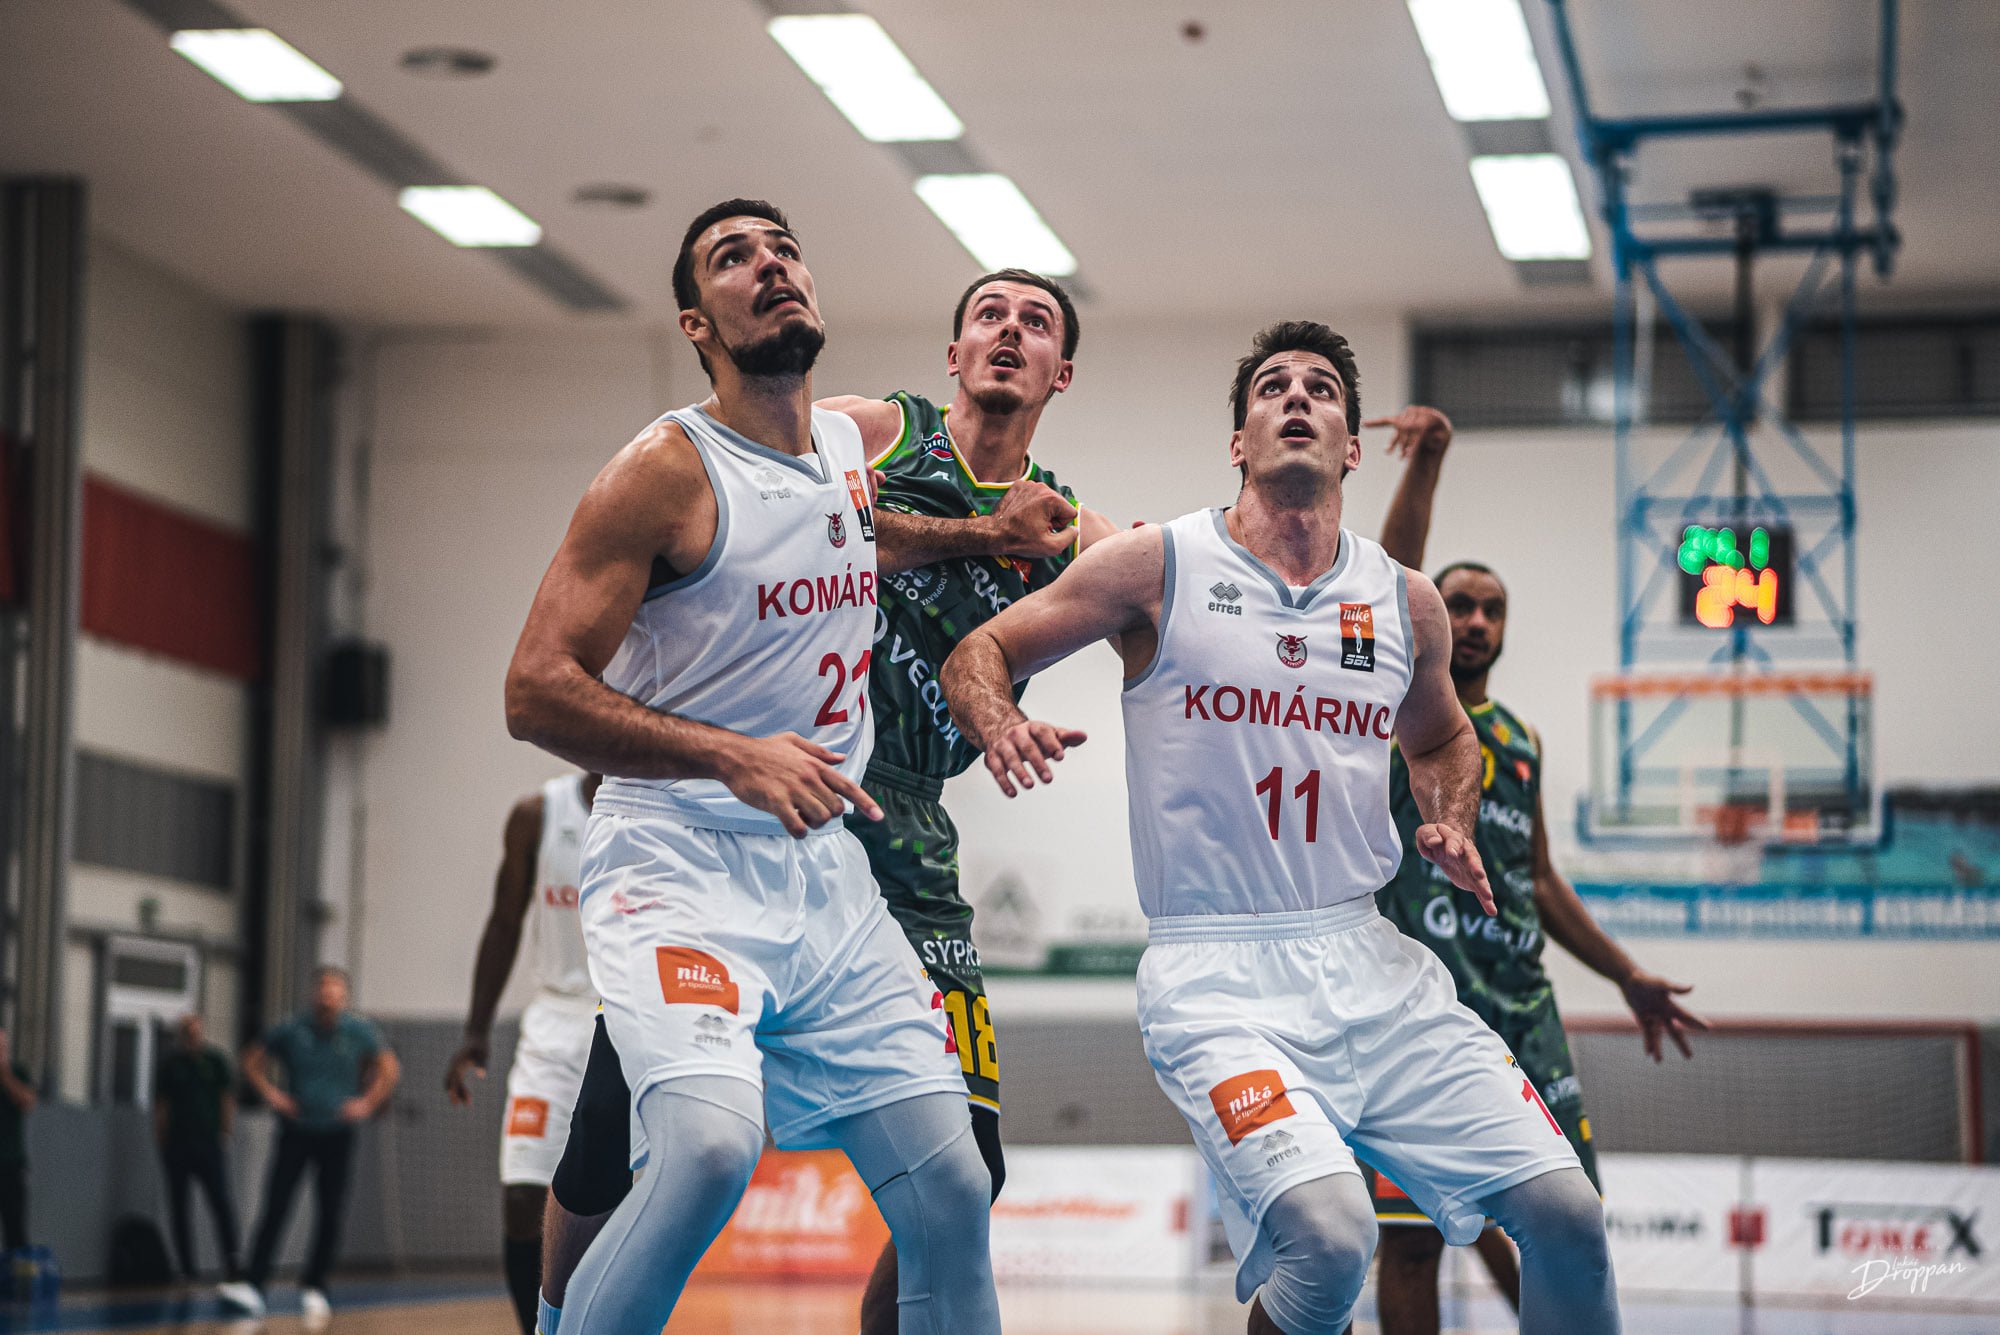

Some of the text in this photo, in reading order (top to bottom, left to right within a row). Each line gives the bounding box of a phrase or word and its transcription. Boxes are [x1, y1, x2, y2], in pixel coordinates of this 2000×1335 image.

[757, 562, 878, 621] KOMÁR
[1208, 600, 1242, 617] errea
[1342, 605, 1371, 624] niké
[813, 649, 872, 728] 21
[1343, 653, 1372, 669] SBL
[1255, 766, 1321, 843] 11
[943, 989, 1000, 1083] 18
